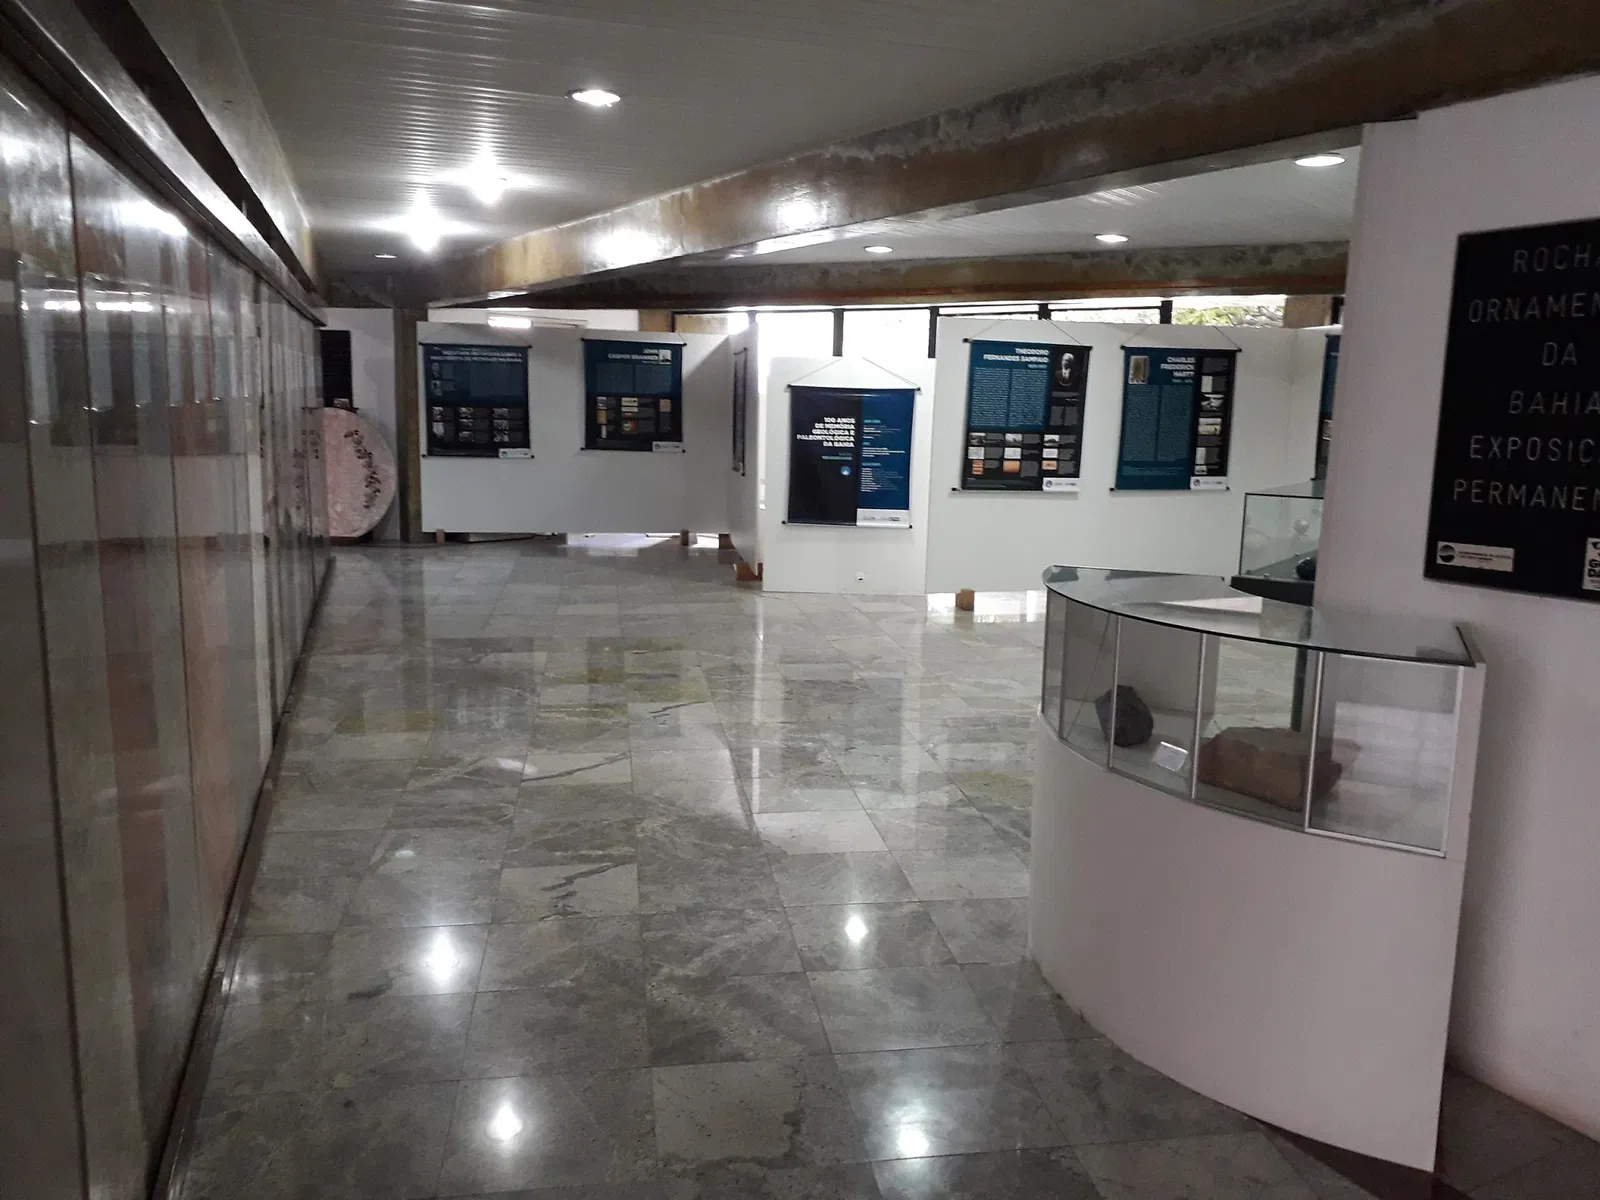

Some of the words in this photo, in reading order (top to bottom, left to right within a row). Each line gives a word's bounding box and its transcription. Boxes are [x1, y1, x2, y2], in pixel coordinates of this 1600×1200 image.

[1513, 244, 1600, 273] ROCH
[1542, 341, 1577, 366] DA
[1508, 390, 1600, 415] BAHIA
